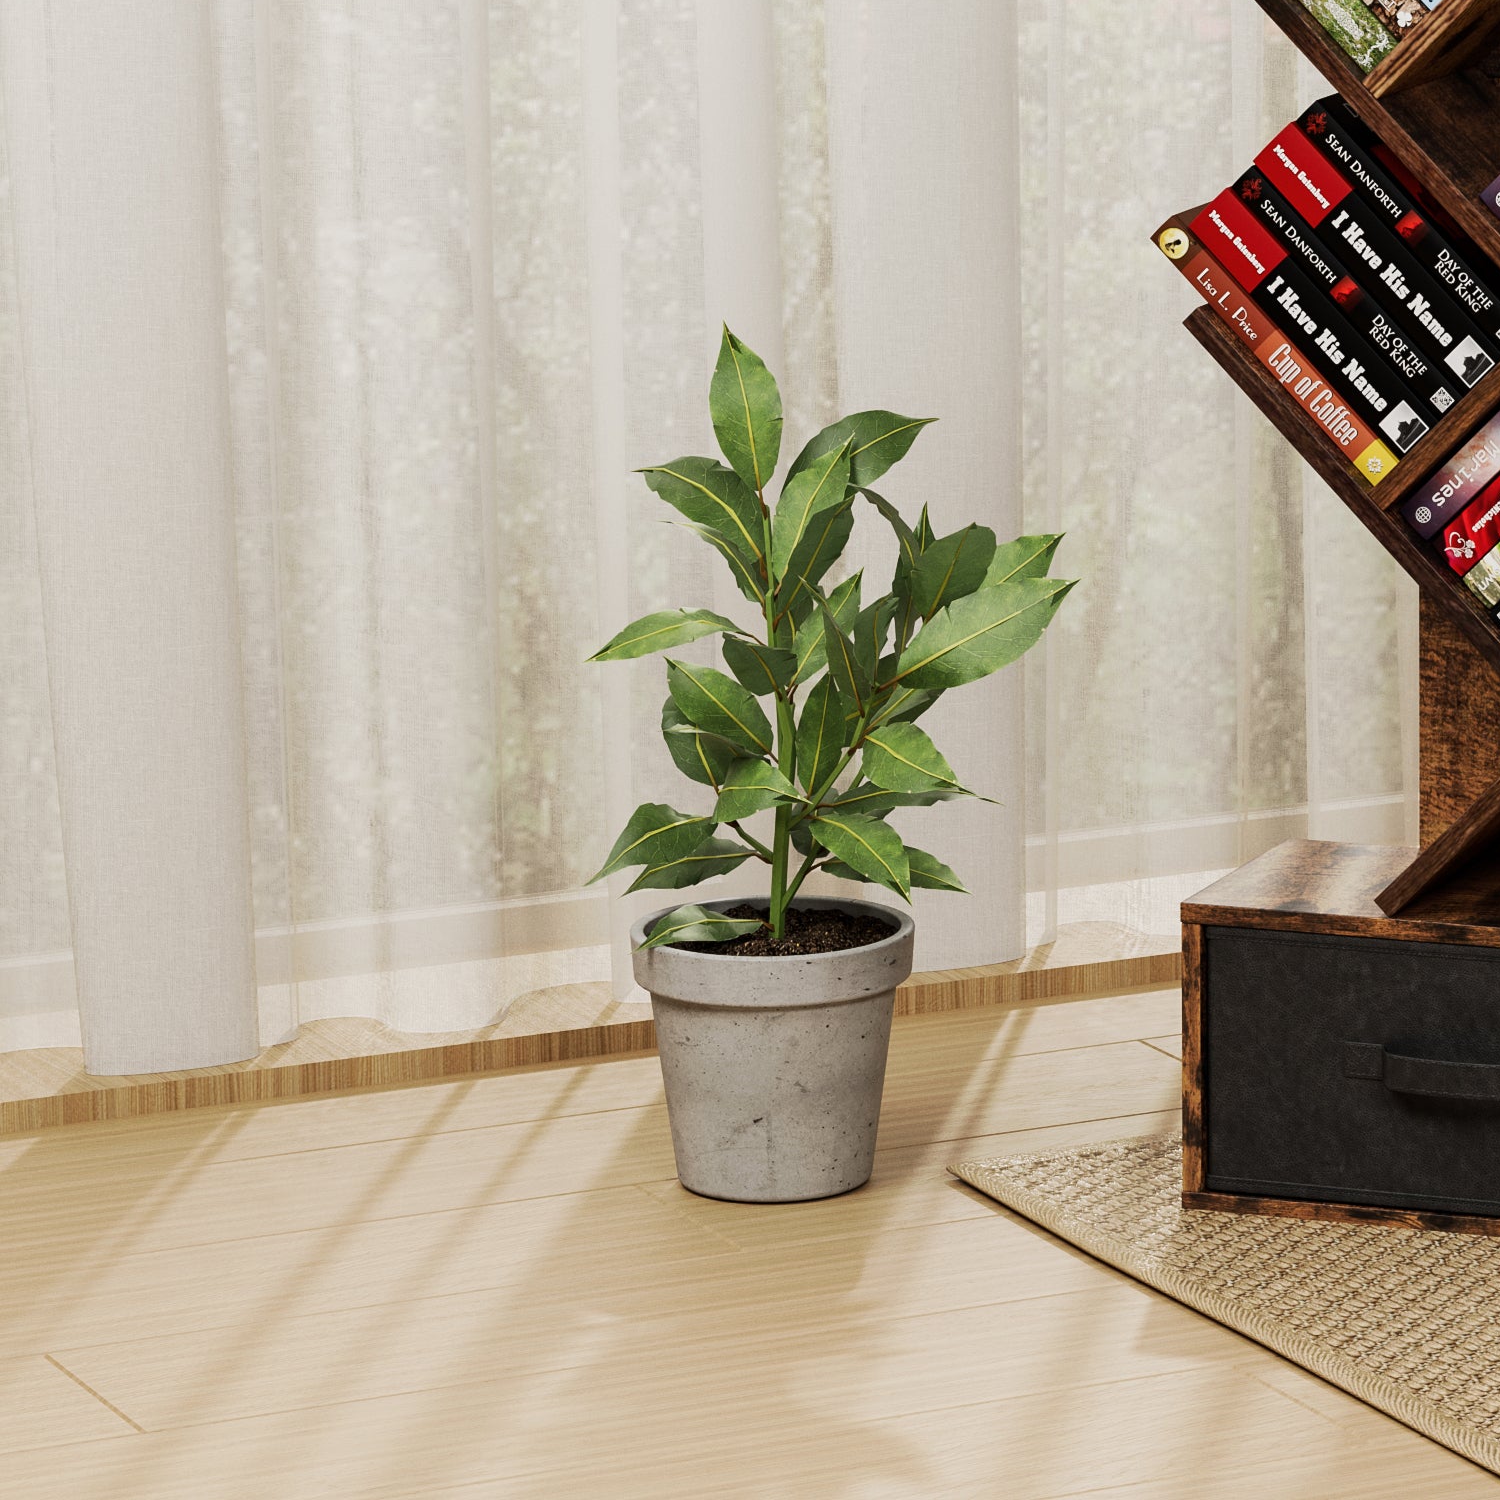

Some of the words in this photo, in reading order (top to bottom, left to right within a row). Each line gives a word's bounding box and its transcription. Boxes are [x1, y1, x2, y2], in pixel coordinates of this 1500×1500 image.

[1197, 268, 1217, 296] Lisa
[1218, 291, 1234, 310] L.
[1232, 307, 1258, 340] Price
[1332, 210, 1349, 229] I
[1342, 222, 1382, 270] Have
[1380, 263, 1410, 300] His
[1407, 293, 1453, 347] Name
[1267, 276, 1284, 294] I
[1277, 287, 1318, 335] Have
[1315, 328, 1345, 365] His
[1342, 358, 1387, 411] Name
[1268, 342, 1301, 383] Cup
[1293, 376, 1322, 402] of
[1309, 387, 1359, 447] Coffee
[1431, 440, 1500, 506] Marines
